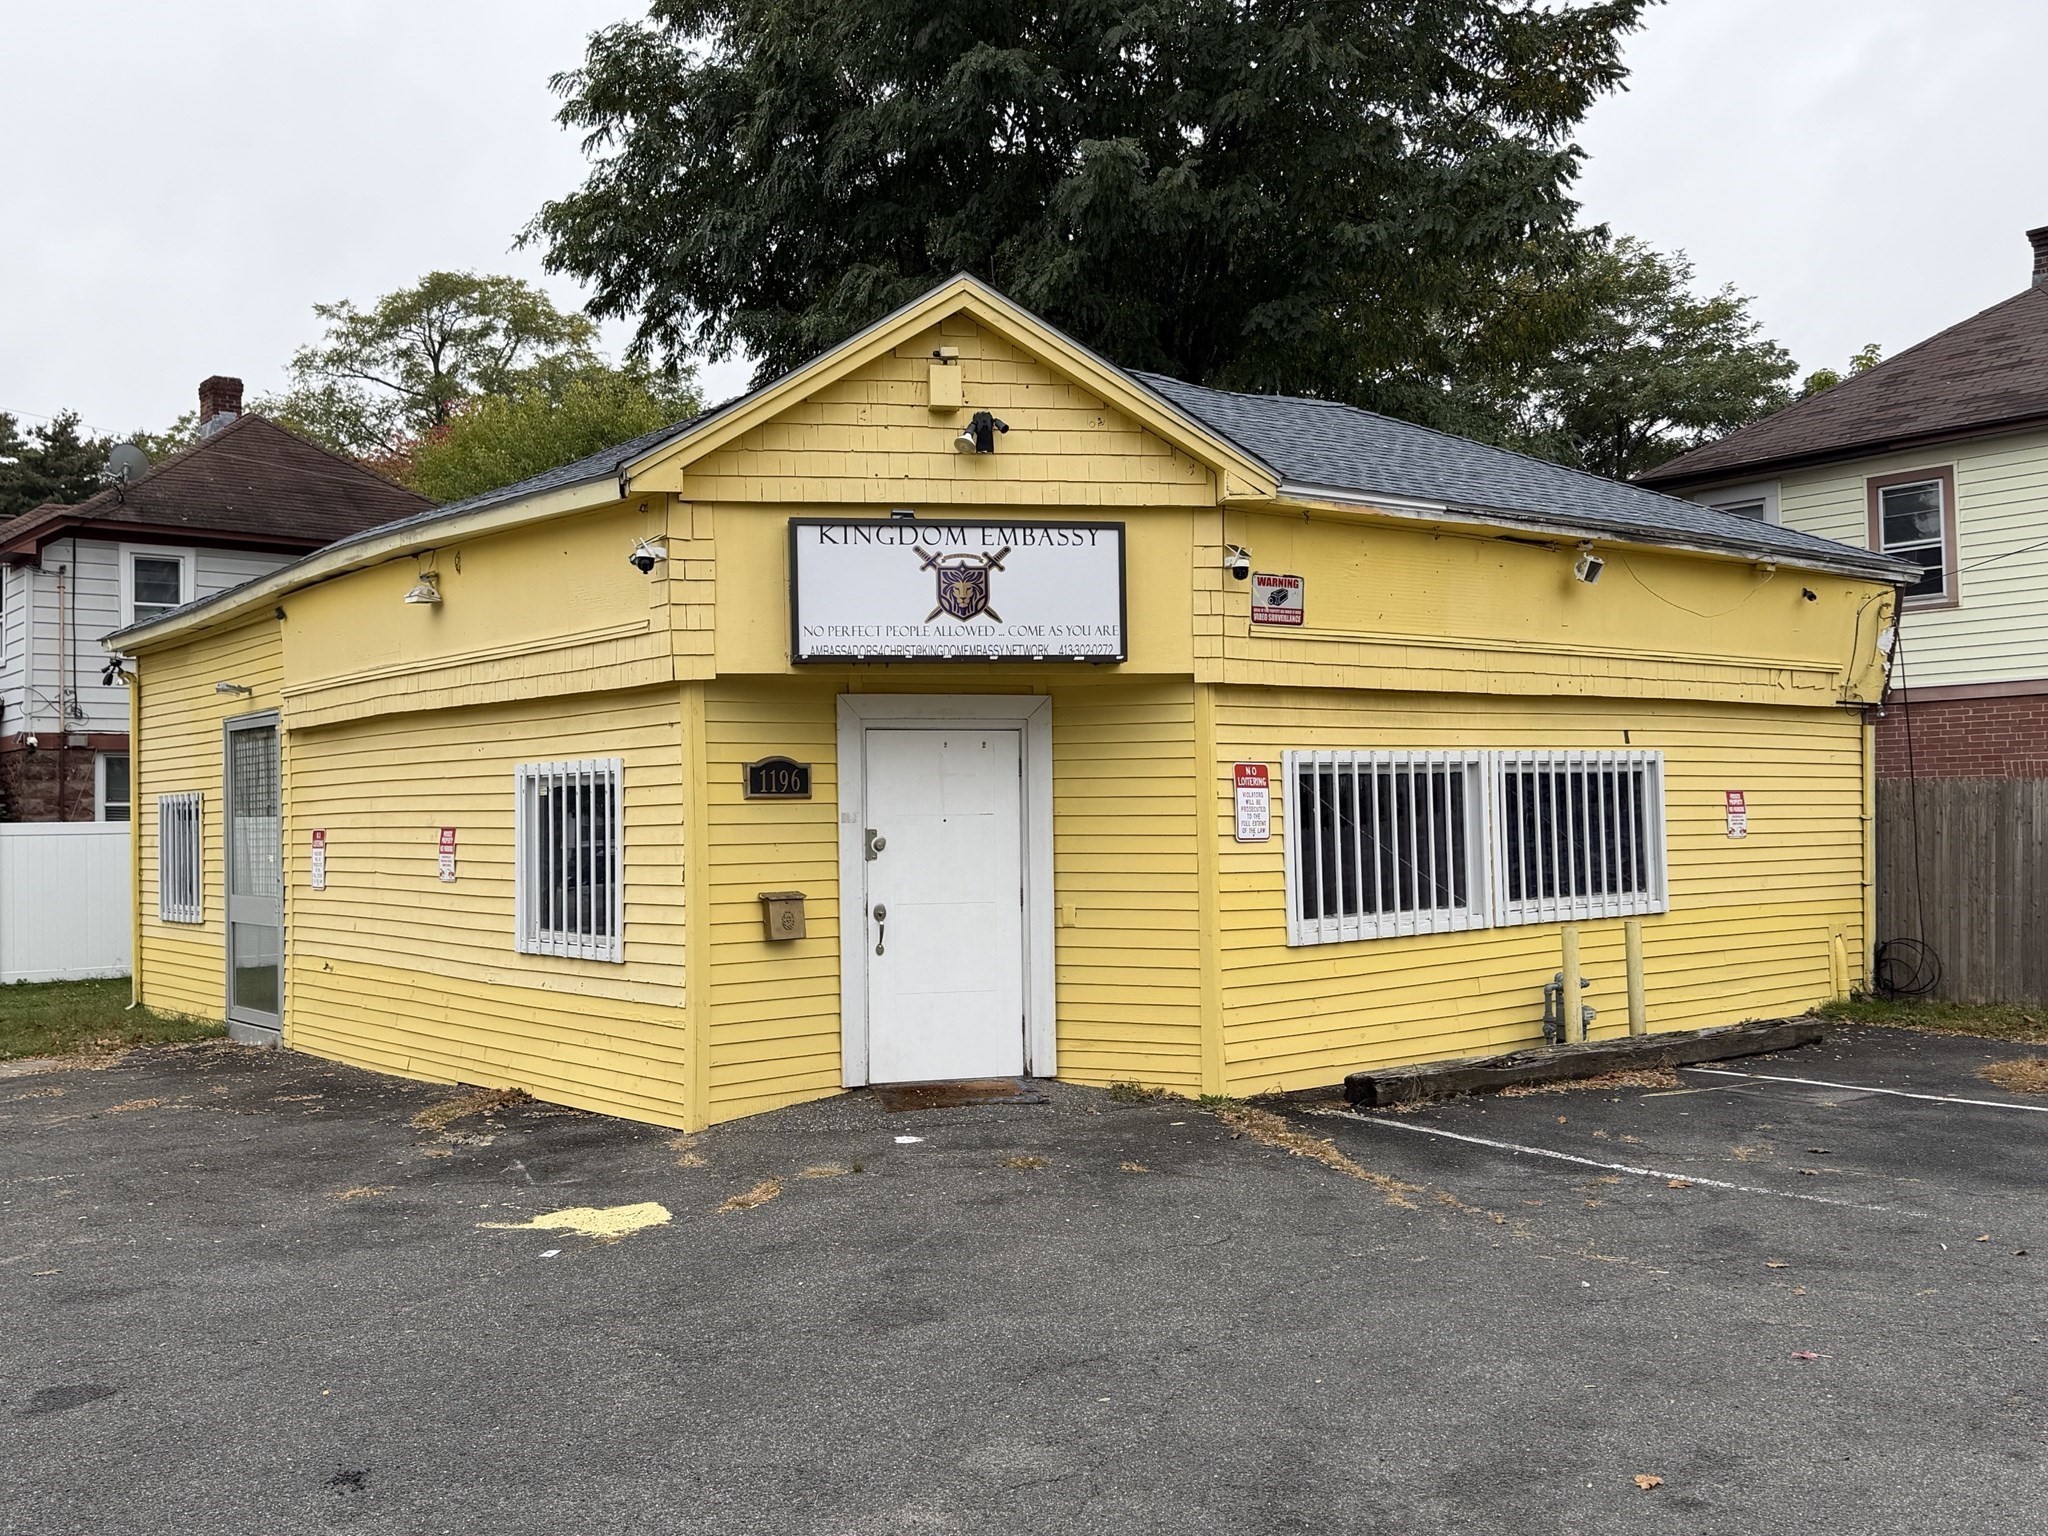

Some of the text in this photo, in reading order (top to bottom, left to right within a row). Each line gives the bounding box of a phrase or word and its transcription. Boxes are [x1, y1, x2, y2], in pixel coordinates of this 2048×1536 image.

[819, 525, 1098, 546] KINGDOM EMBASSY
[1257, 576, 1299, 589] WARNING
[803, 625, 824, 637] NO
[828, 625, 882, 637] PERFECT
[886, 625, 930, 637] PEOPLE
[934, 625, 995, 637] ALLOWED
[1008, 625, 1045, 637] COME
[1048, 625, 1063, 637] AS
[1066, 625, 1091, 637] YOU
[1094, 625, 1119, 637] ARE
[1245, 766, 1257, 776] NO
[760, 769, 801, 793] 1196
[1237, 776, 1267, 786] LOITERING
